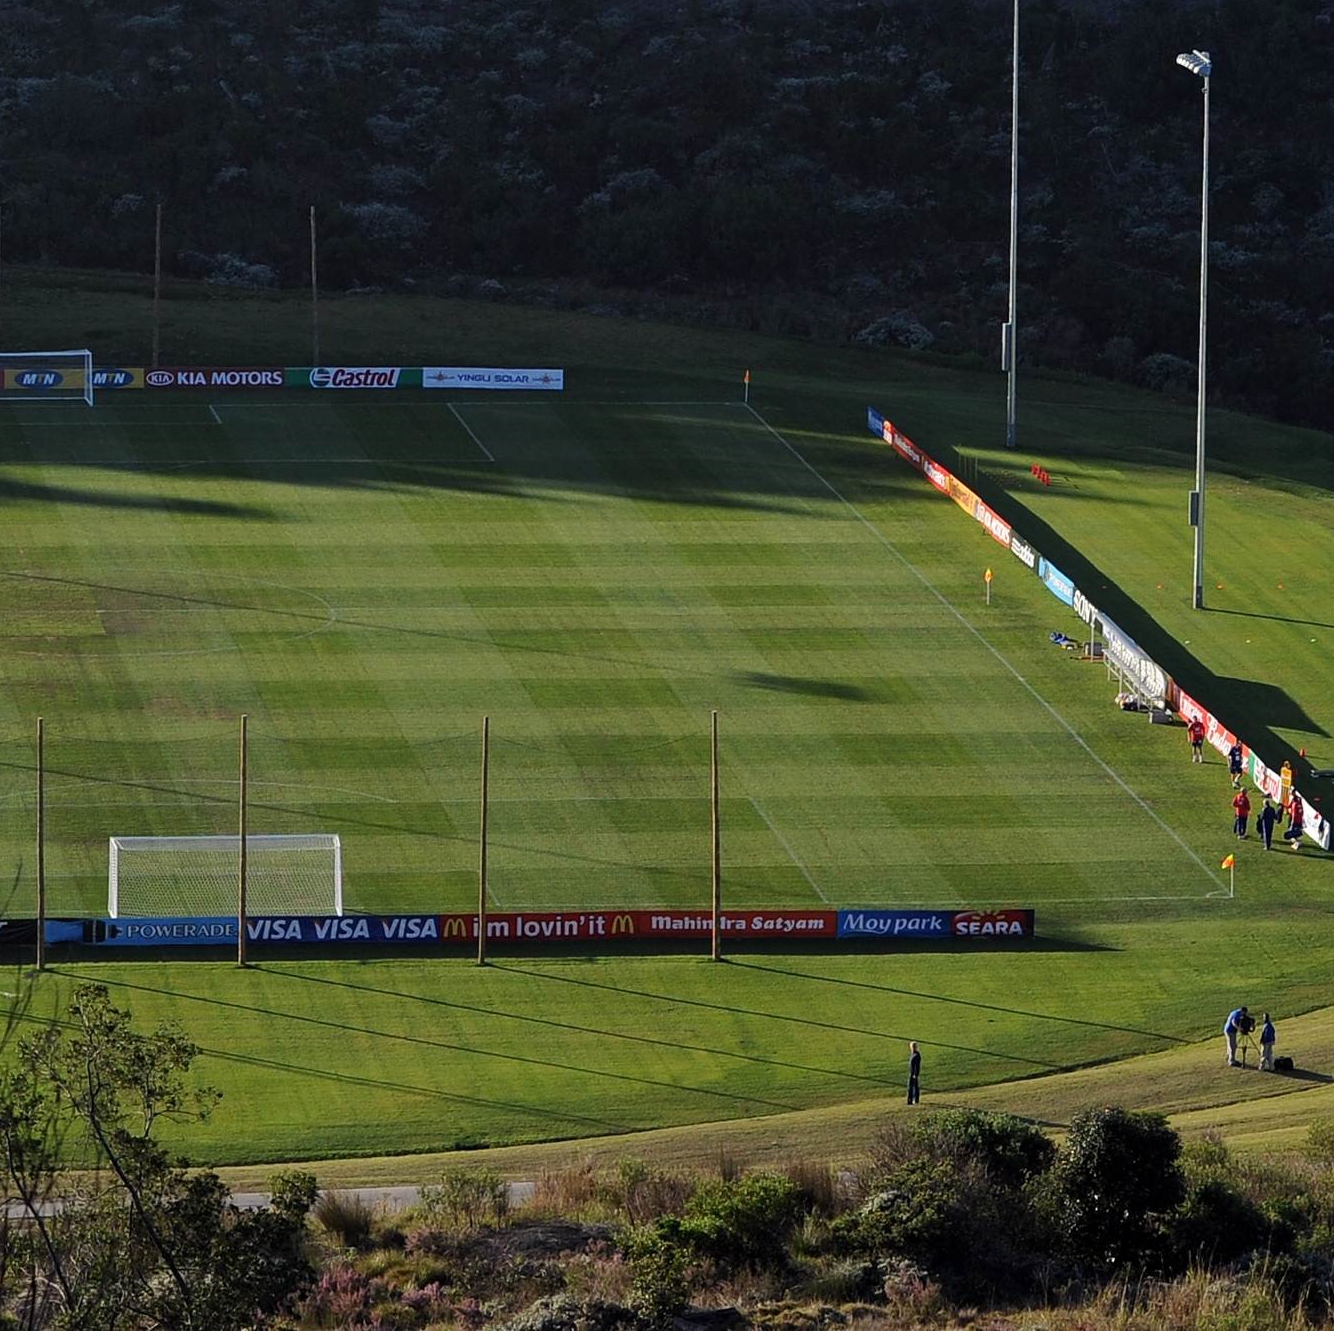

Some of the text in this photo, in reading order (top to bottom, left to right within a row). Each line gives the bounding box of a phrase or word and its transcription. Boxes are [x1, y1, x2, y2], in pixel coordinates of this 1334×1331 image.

[23, 373, 55, 385] MTN
[93, 372, 126, 384] MTN
[151, 371, 283, 386] KIA KIA MOTORS
[331, 369, 396, 387] Castrol
[494, 374, 530, 384] SOLAR
[1074, 589, 1099, 625] SONY
[127, 923, 236, 938] POWERADE
[246, 918, 438, 940] VISA VISA VISA
[750, 915, 824, 932] Satyam
[843, 913, 942, 935] Moy park
[955, 921, 1023, 935] SEARA
